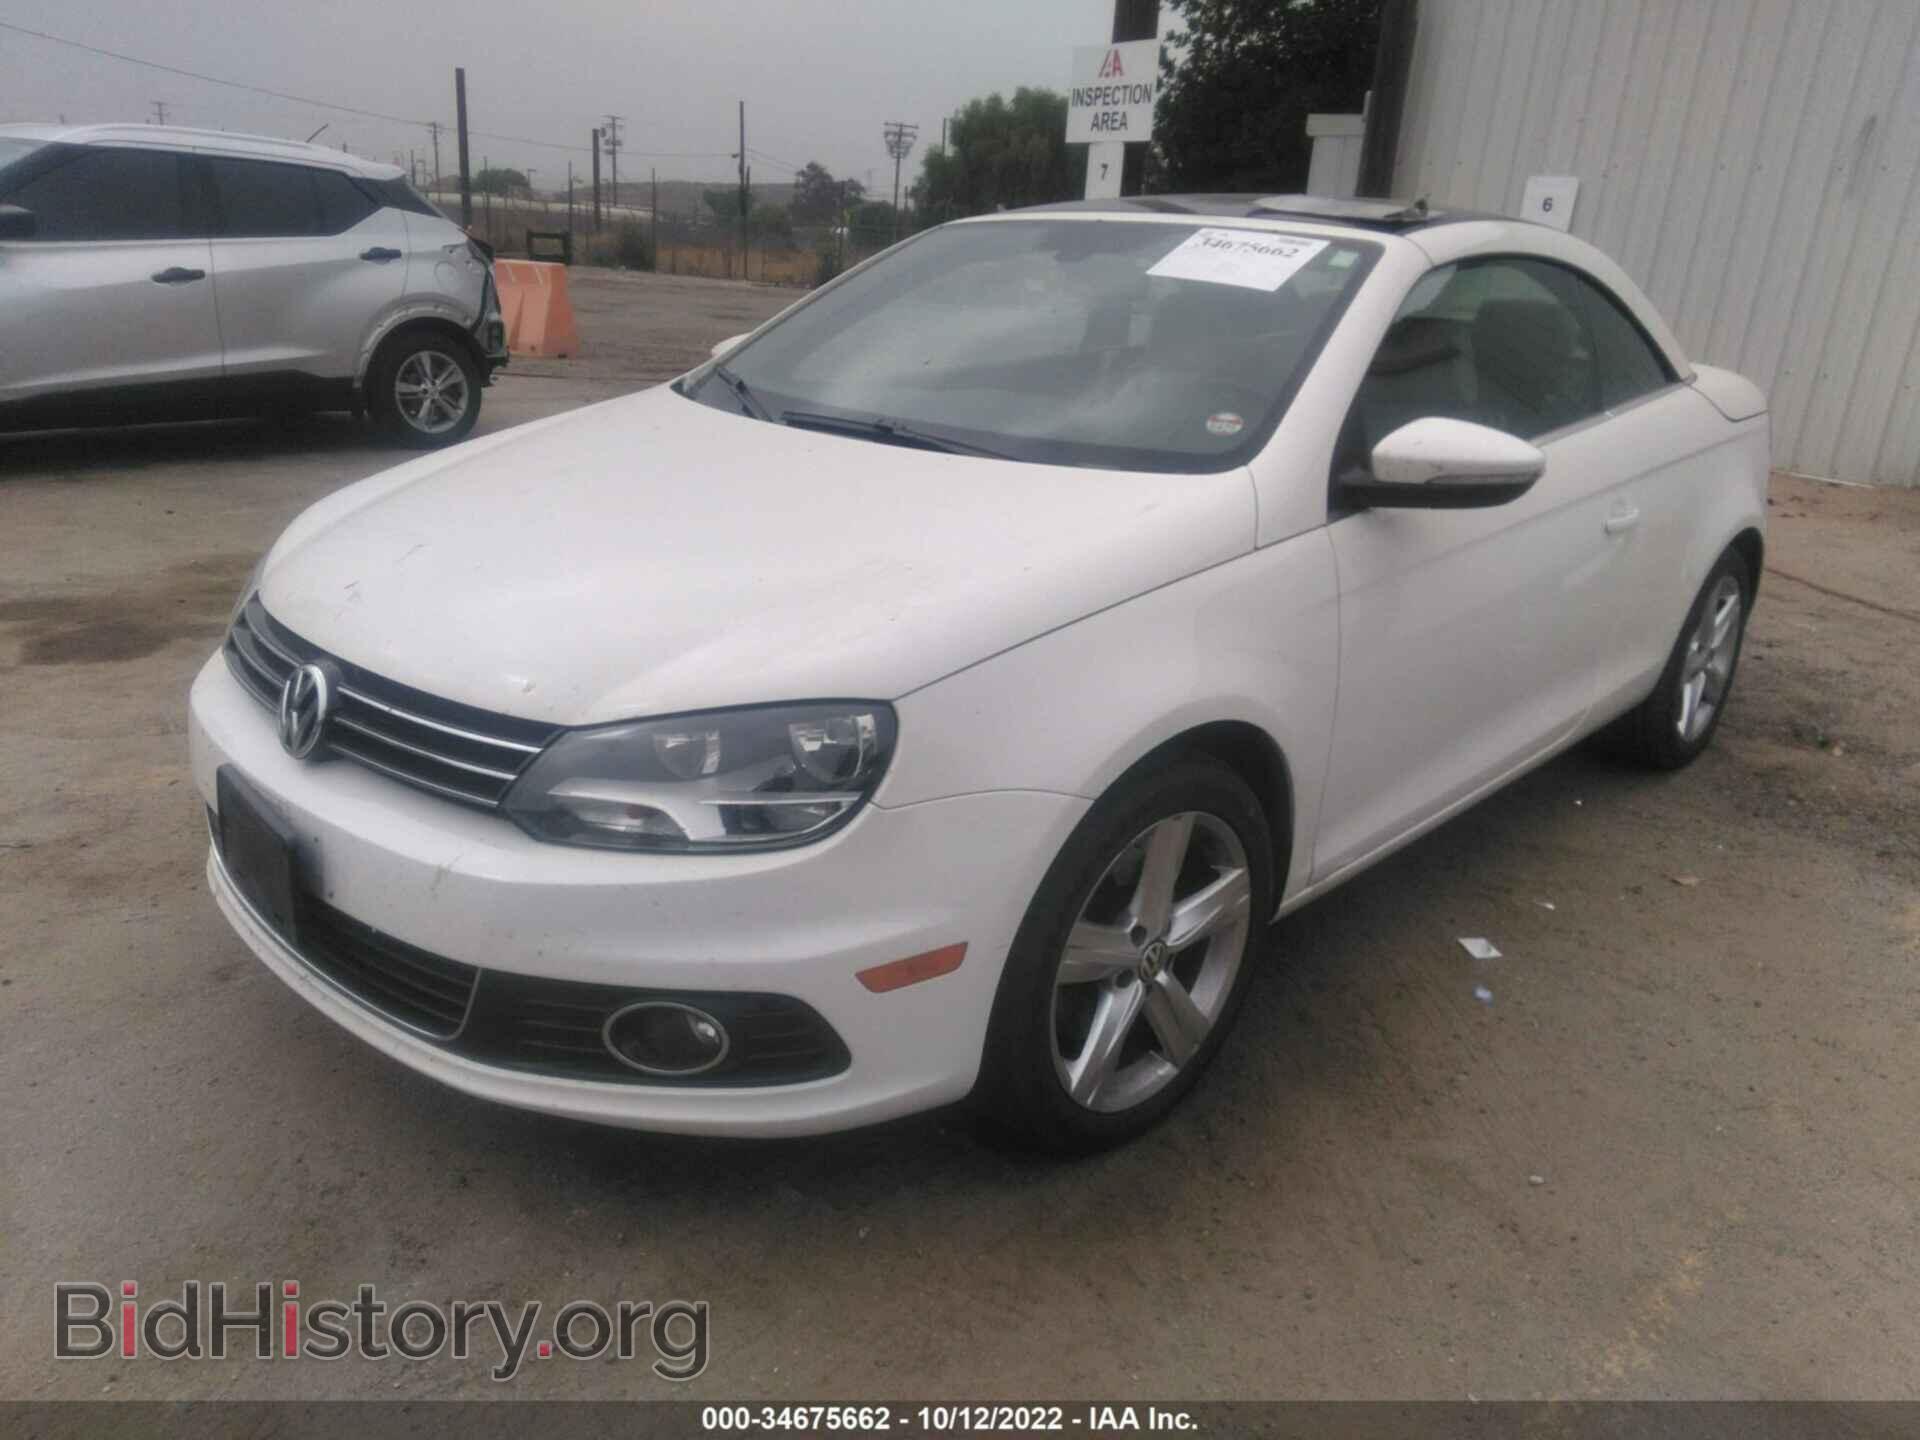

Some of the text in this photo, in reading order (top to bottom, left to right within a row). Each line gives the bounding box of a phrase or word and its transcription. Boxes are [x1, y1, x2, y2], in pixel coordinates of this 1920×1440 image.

[1071, 83, 1152, 107] INSPECTION
[1090, 111, 1128, 132] AREA
[1100, 163, 1109, 180] 7
[1543, 197, 1552, 212] 6
